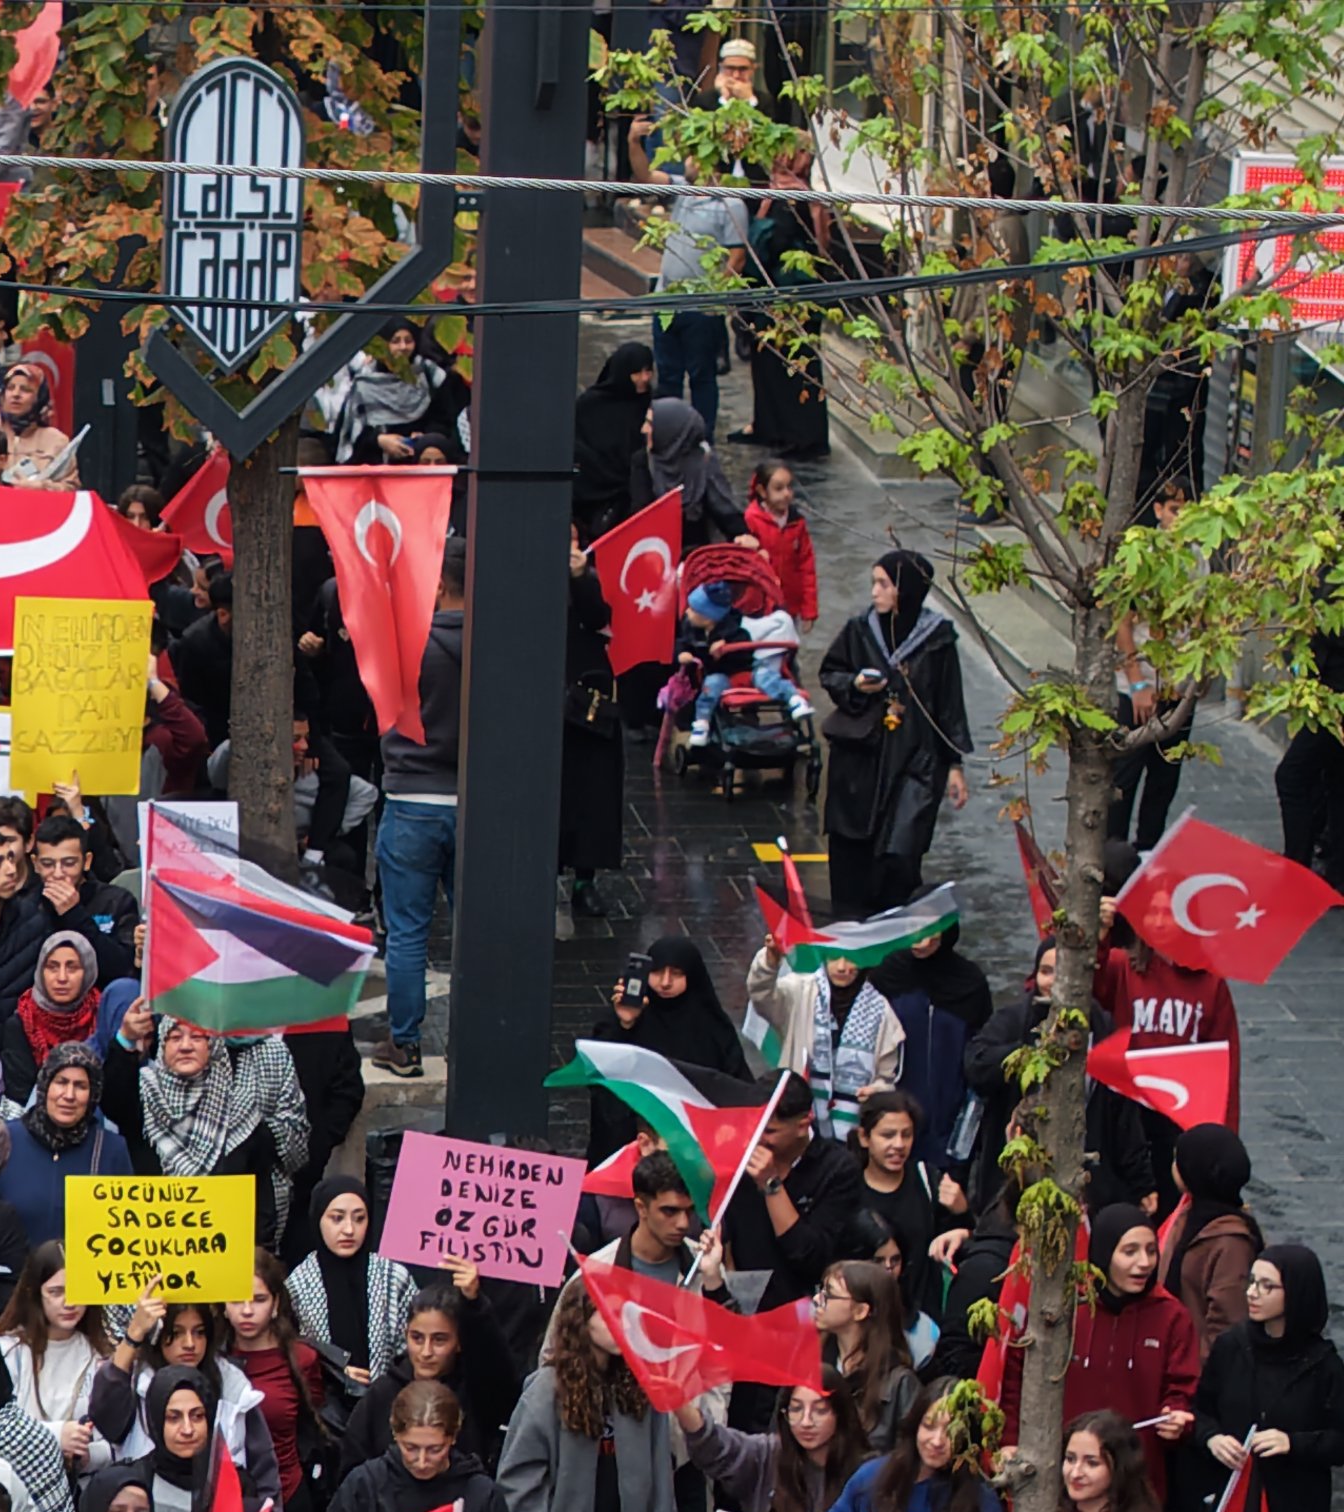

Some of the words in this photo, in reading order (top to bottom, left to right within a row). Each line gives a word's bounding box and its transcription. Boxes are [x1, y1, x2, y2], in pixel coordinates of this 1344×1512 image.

[442, 1150, 564, 1186] NEHİRDEN
[92, 1181, 206, 1203] GÜCÜNÜZ
[440, 1178, 537, 1209] DENİZE
[107, 1206, 214, 1228] SADECE
[86, 1232, 227, 1258] ÇOCUKLARA
[419, 1230, 544, 1268] FİLİSTİN
